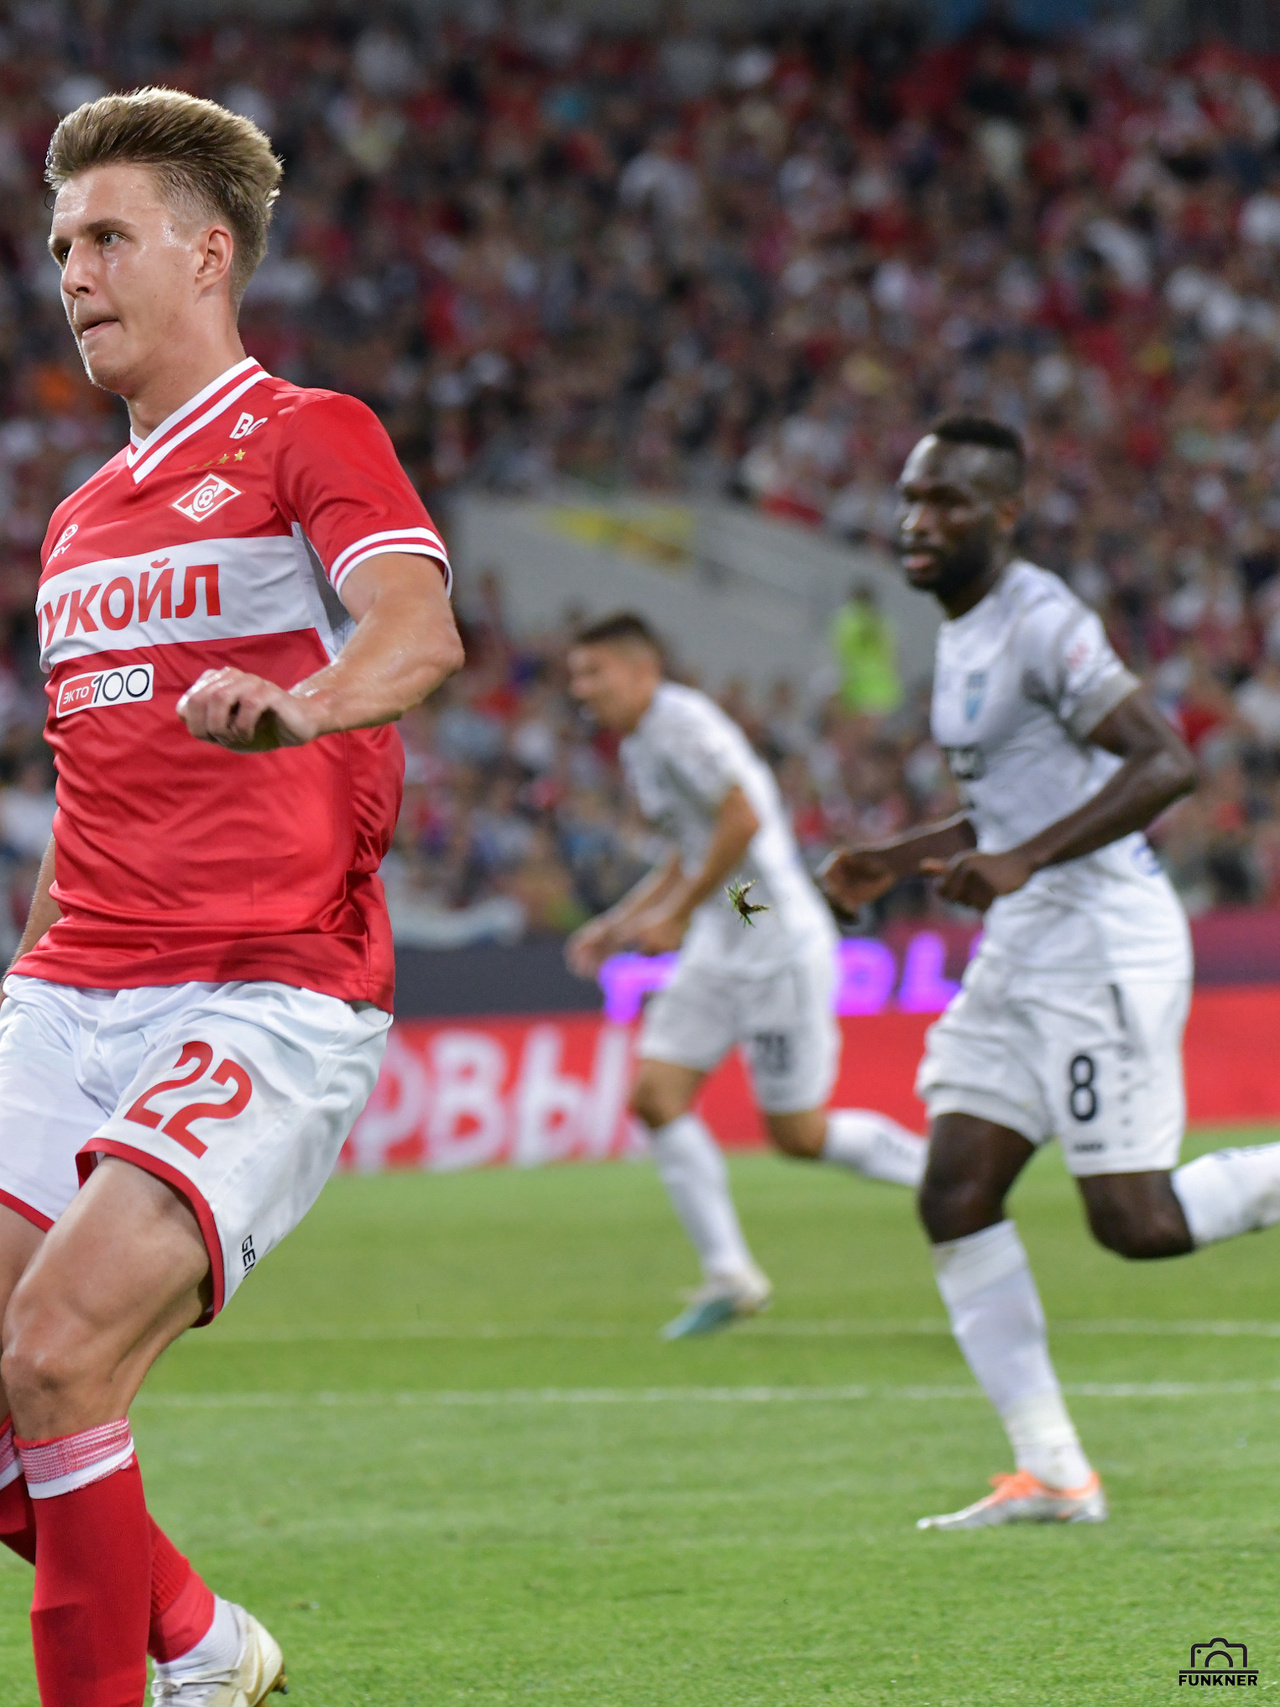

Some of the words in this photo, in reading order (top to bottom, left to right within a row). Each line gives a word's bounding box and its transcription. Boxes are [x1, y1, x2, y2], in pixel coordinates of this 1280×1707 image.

[38, 557, 221, 649] УКОЙЛ
[62, 685, 90, 705] ЭКТО
[91, 668, 150, 704] 100
[123, 1041, 252, 1159] 22
[1069, 1054, 1097, 1122] 8
